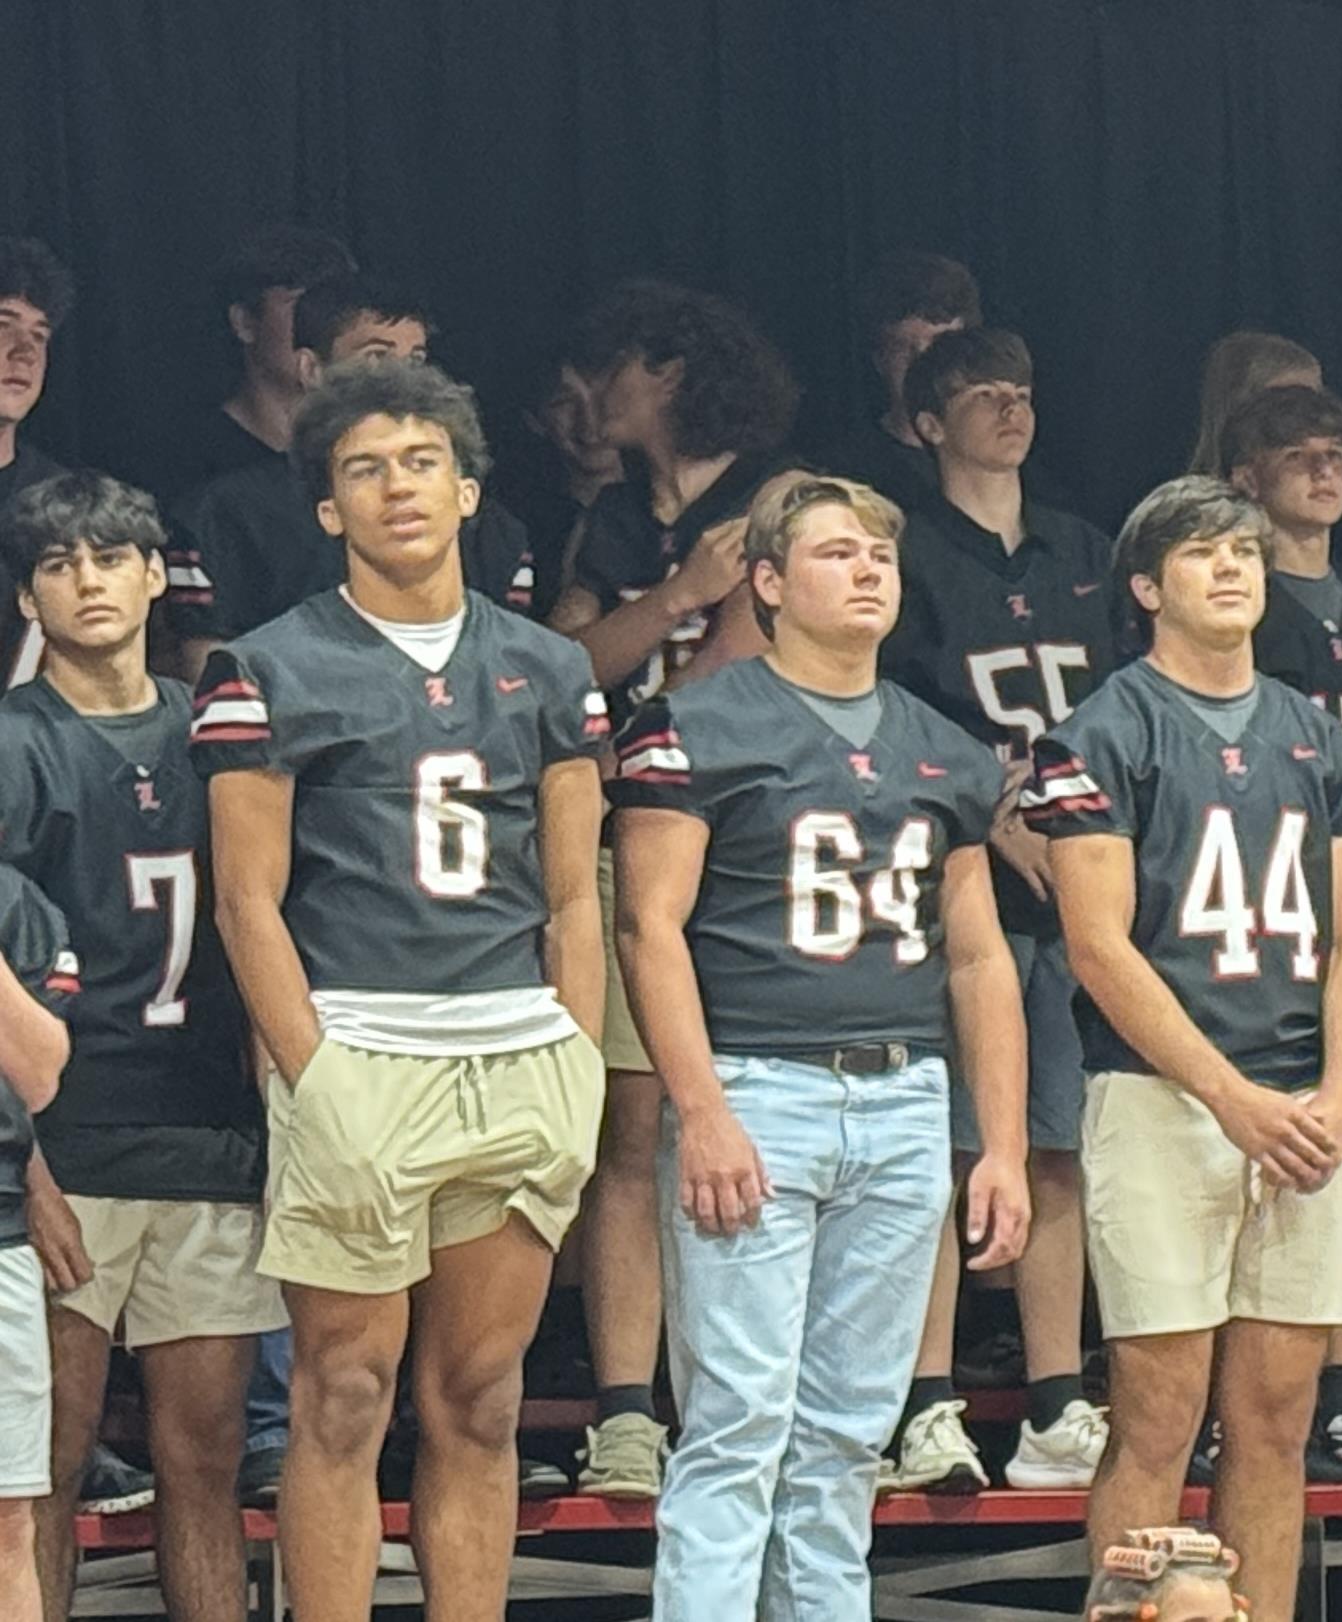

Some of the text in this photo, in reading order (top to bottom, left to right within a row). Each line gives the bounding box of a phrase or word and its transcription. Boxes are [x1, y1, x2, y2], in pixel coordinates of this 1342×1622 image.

[415, 752, 488, 897] 6
[791, 811, 932, 966] 64
[1179, 805, 1320, 982] 44
[126, 850, 197, 1026] 7
